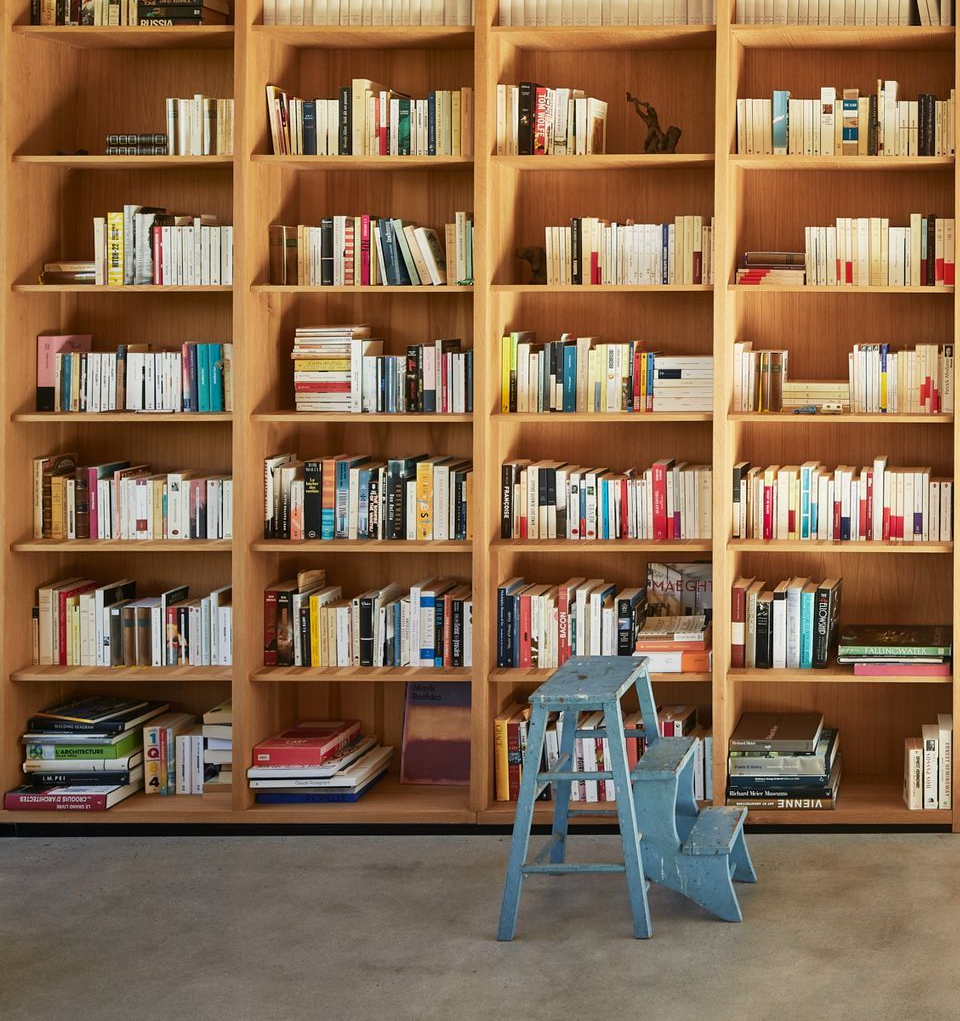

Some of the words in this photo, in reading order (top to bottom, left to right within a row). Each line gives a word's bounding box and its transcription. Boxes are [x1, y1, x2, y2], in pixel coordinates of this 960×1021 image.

[538, 93, 546, 109] TOM
[538, 111, 546, 136] WOLFE
[652, 580, 713, 592] MAEGHT
[818, 597, 828, 635] FELLOWSHIP
[863, 647, 927, 656] FALLINGWATER
[412, 684, 435, 692] Mark
[412, 693, 441, 701] Rothko
[305, 795, 351, 803] RIOPELLE
[777, 799, 823, 808] VIENNE
